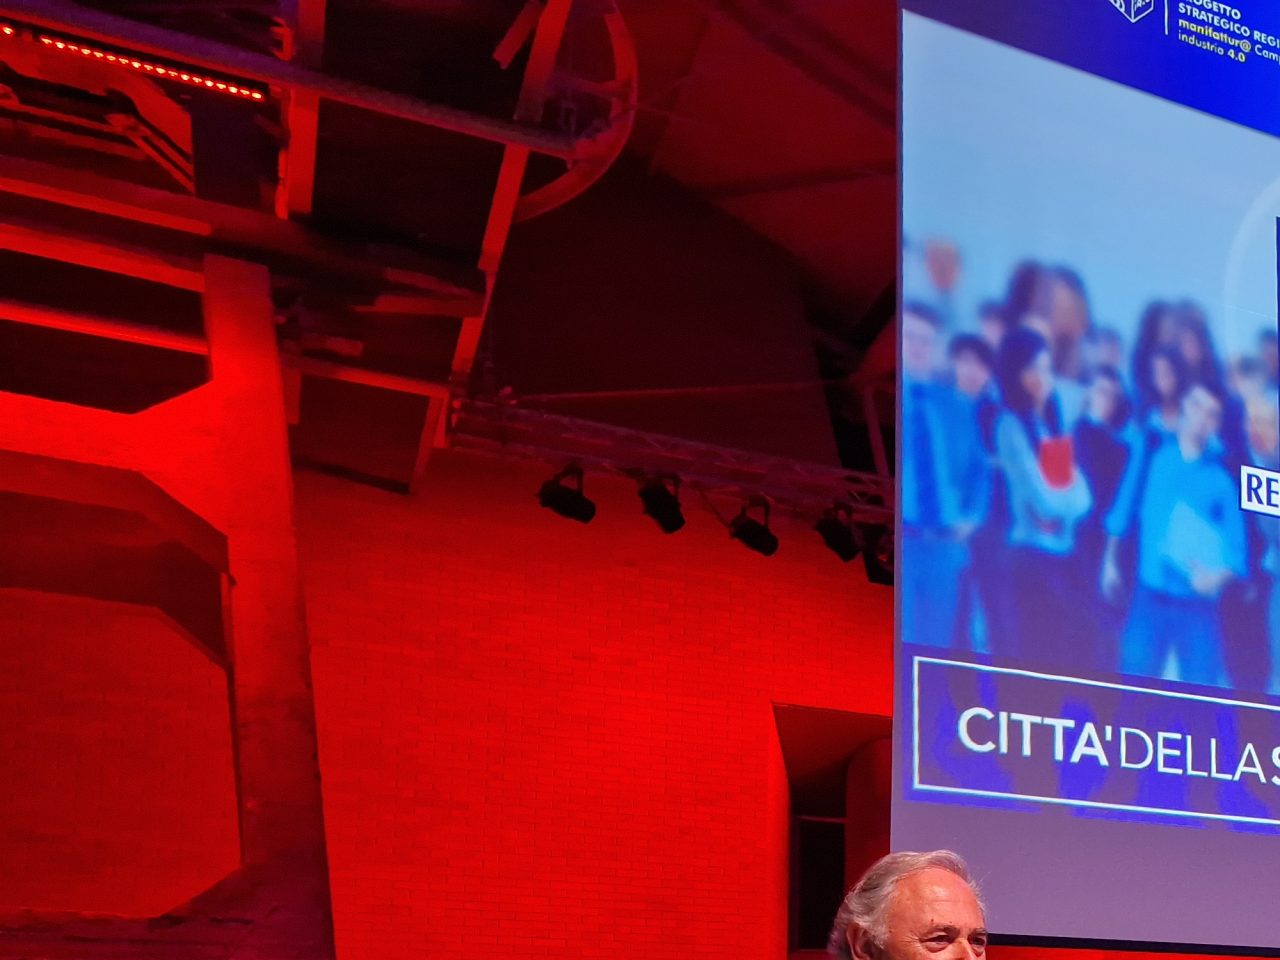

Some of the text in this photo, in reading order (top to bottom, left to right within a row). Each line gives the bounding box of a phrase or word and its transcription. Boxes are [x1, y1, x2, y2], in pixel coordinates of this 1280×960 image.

[1178, 3, 1250, 37] STRATEGICO
[1186, 0, 1241, 20] OGETTO
[1178, 19, 1251, 52] manifattur@
[1178, 30, 1246, 63] industria 4.0
